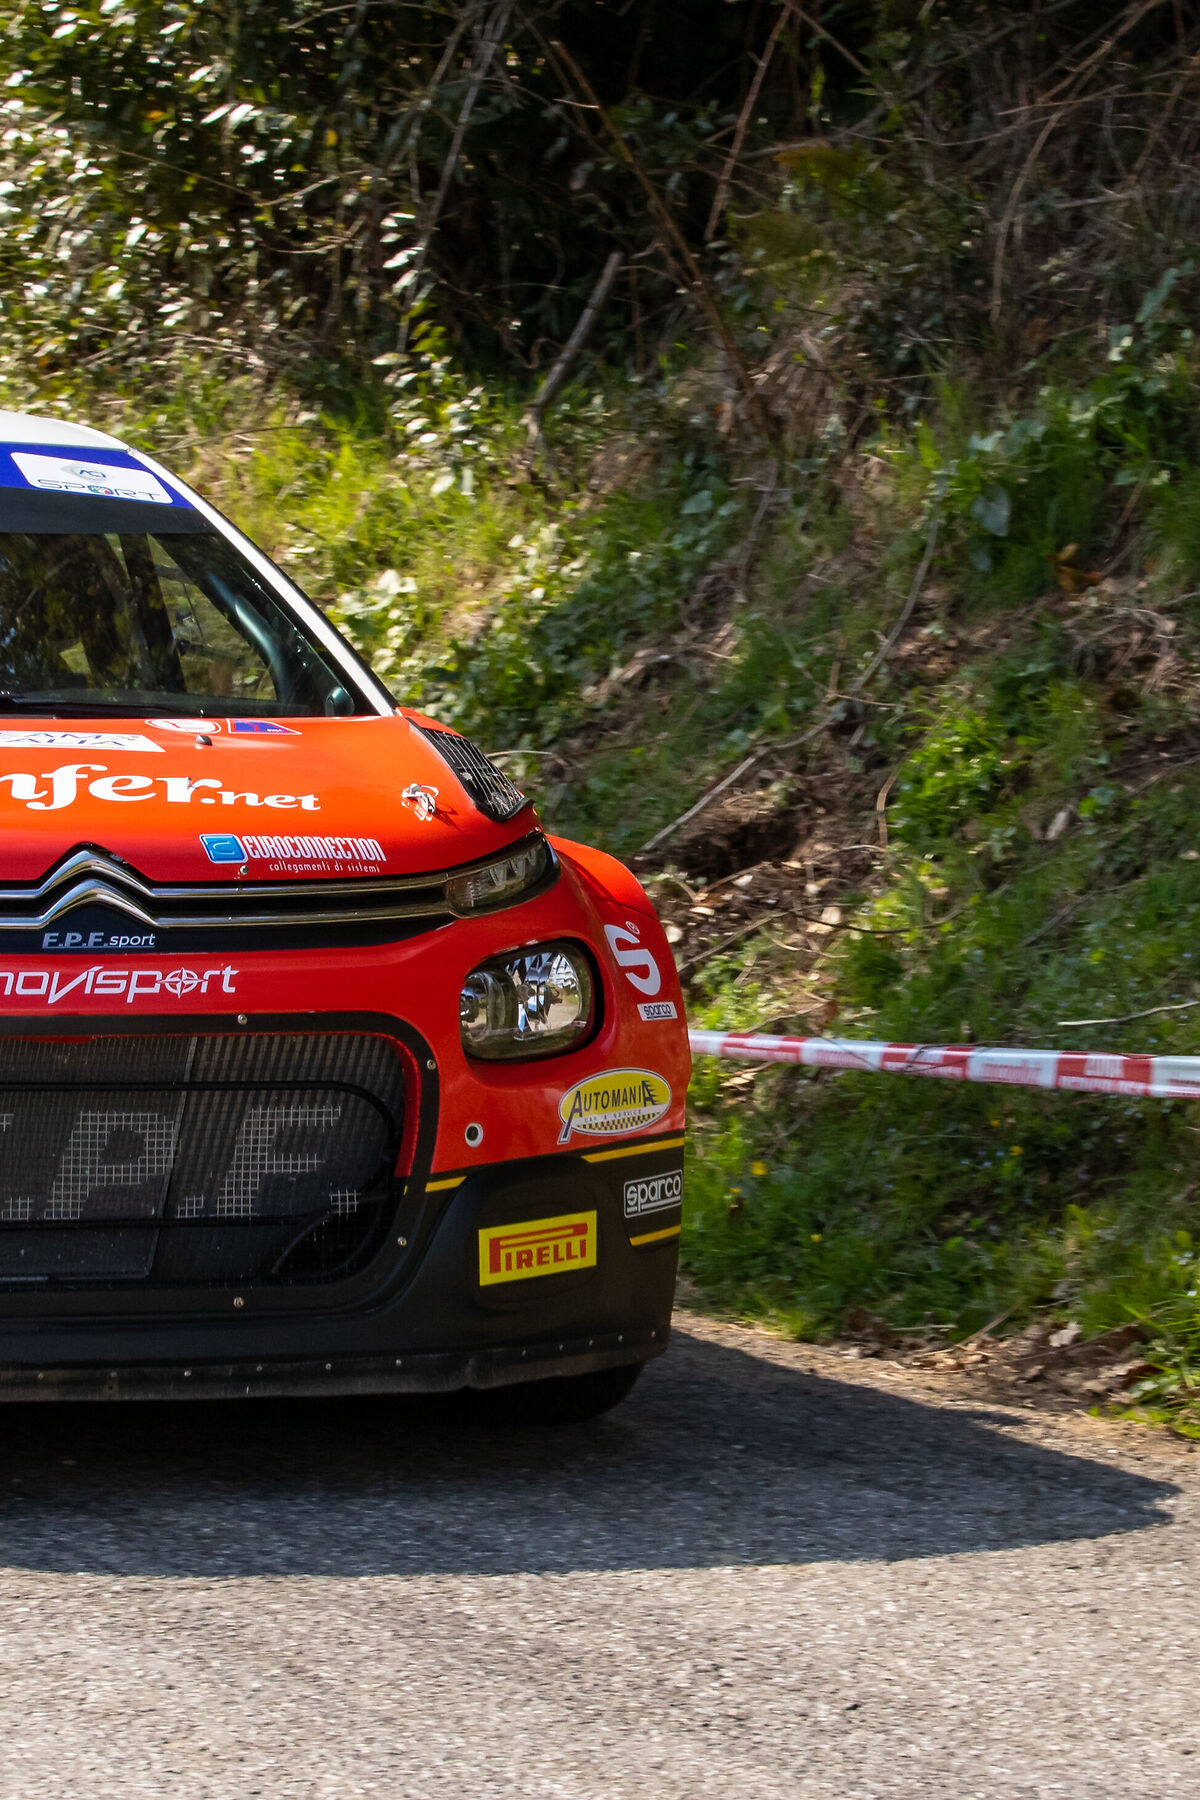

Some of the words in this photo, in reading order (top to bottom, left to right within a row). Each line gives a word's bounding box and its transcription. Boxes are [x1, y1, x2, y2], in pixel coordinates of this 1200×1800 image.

[37, 478, 161, 500] SPORT
[242, 835, 387, 861] EUROCONNECTION
[269, 860, 330, 873] collegamenti
[334, 862, 344, 871] di
[347, 862, 380, 873] sistemi
[644, 1004, 672, 1017] sparco
[562, 1080, 657, 1141] AUTOMANIA
[626, 1176, 681, 1211] sparco
[489, 1222, 588, 1274] PIRELLI
